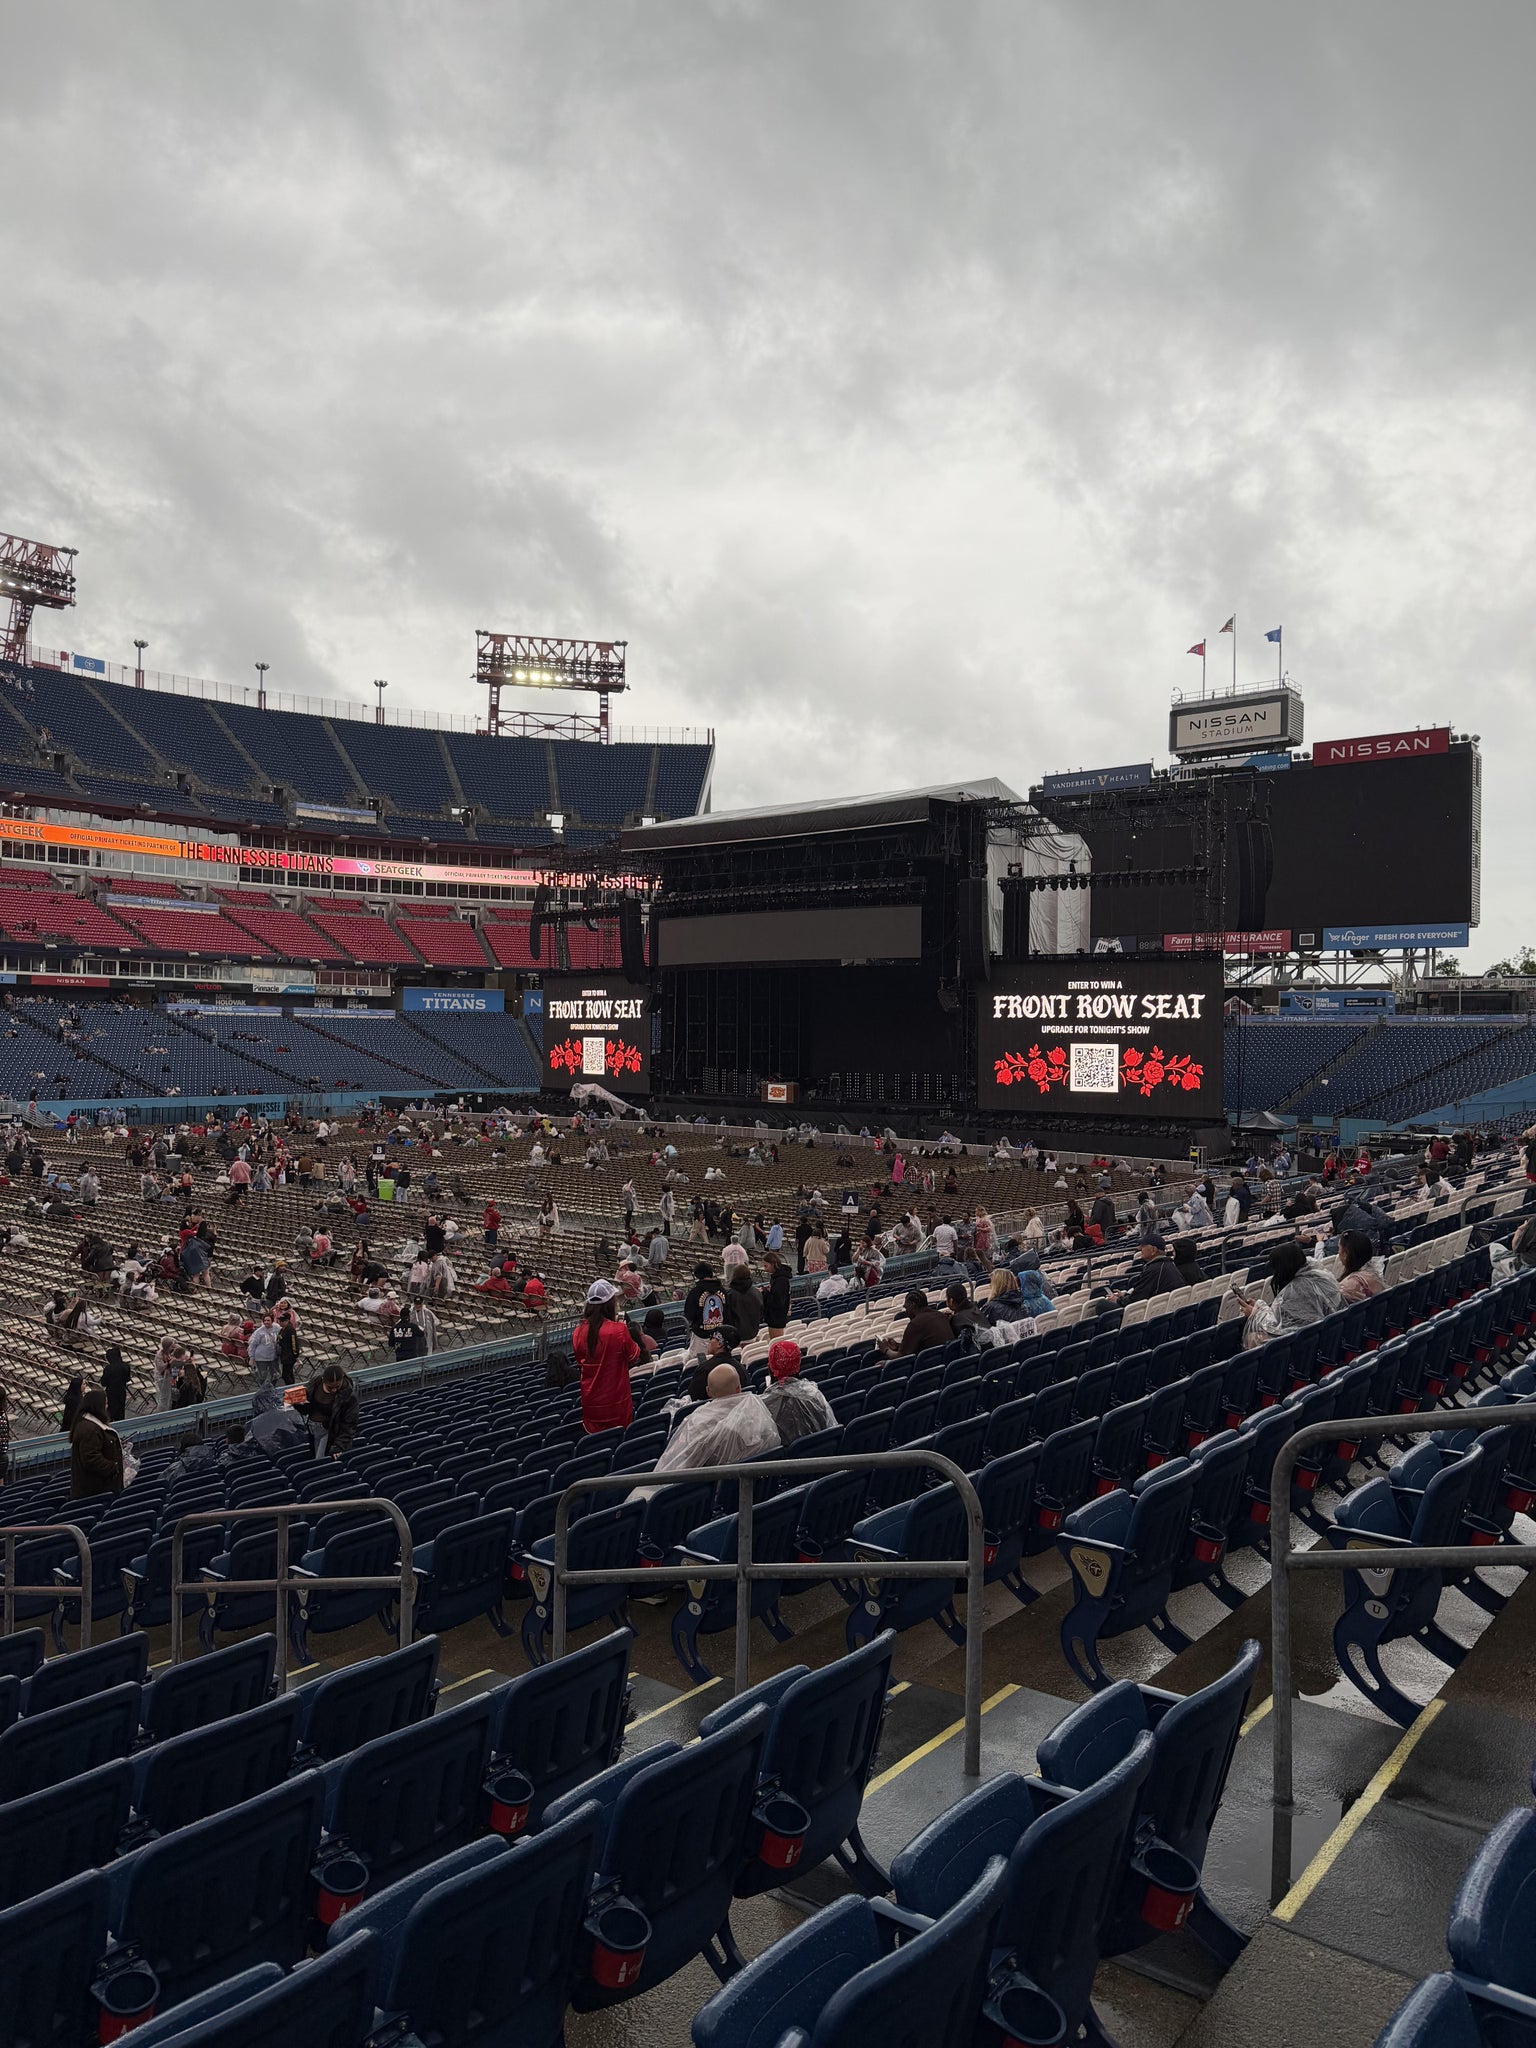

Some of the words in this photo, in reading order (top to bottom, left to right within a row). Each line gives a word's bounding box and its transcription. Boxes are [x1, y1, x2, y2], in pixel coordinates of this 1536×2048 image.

[1189, 710, 1267, 731] NISSAN
[1201, 725, 1254, 739] STADIUM
[1330, 736, 1430, 760] NISSAN
[1051, 777, 1096, 790] VANDERBILT
[1109, 773, 1140, 784] HEALTH
[70, 832, 94, 842] OFFICIAL
[94, 836, 119, 845] PRIMARY
[119, 839, 146, 848] TICKETING
[146, 842, 169, 850] PARTNER
[178, 841, 204, 860] THE
[207, 844, 283, 868] TENNESSEE
[287, 852, 333, 873] TITANS
[374, 863, 423, 877] SEATGEEK
[444, 870, 465, 878] OFFICIAL
[1171, 936, 1192, 945] Farm
[1226, 932, 1283, 943] INSURANCE
[1341, 930, 1370, 946] Kroger
[1374, 933, 1398, 941] FRESH
[1399, 932, 1416, 940] FOR
[194, 982, 222, 991] verizon
[253, 984, 280, 992] Pinnacle
[1068, 981, 1089, 990] ENTER
[1090, 981, 1100, 989] TO
[1100, 981, 1116, 989] WIN
[1116, 980, 1123, 989] A
[422, 997, 486, 1010] TITANS
[549, 1000, 584, 1019] FRONT
[585, 999, 613, 1019] ROW
[614, 999, 644, 1019] SEAT
[993, 994, 1072, 1019] FRONT
[1076, 994, 1138, 1019] ROW
[1141, 993, 1206, 1019] SEAT
[1041, 1025, 1074, 1034] UPGRADE
[1074, 1025, 1089, 1034] FOR
[1089, 1025, 1127, 1034] TONIGHT'S
[1127, 1025, 1150, 1034] SHOW
[376, 1146, 382, 1154] B
[846, 1195, 855, 1205] A
[693, 1604, 698, 1613] R
[870, 1604, 876, 1613] S
[1373, 1604, 1381, 1614] U
